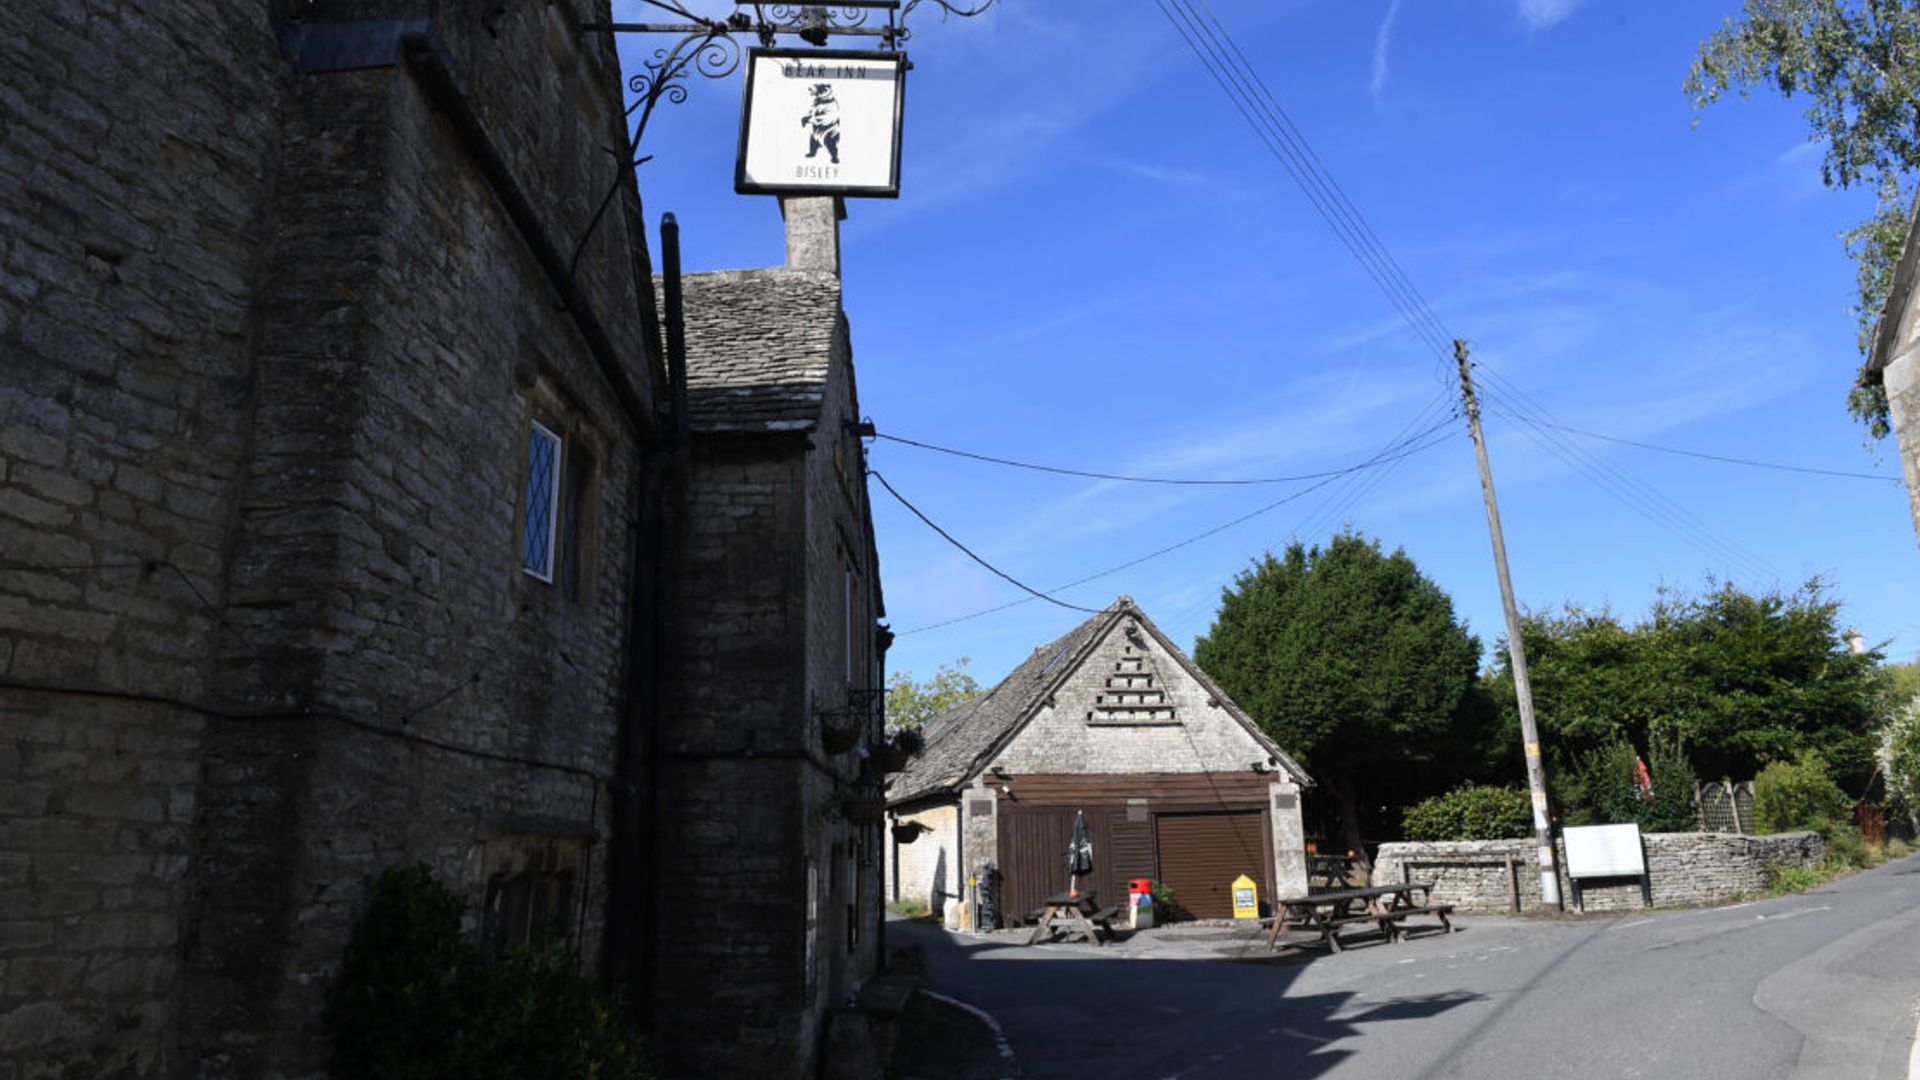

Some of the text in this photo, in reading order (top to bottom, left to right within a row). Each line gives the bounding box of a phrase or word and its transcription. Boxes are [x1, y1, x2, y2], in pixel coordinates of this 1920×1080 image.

[784, 62, 867, 79] BEAR INN
[796, 165, 840, 179] BISLEY
